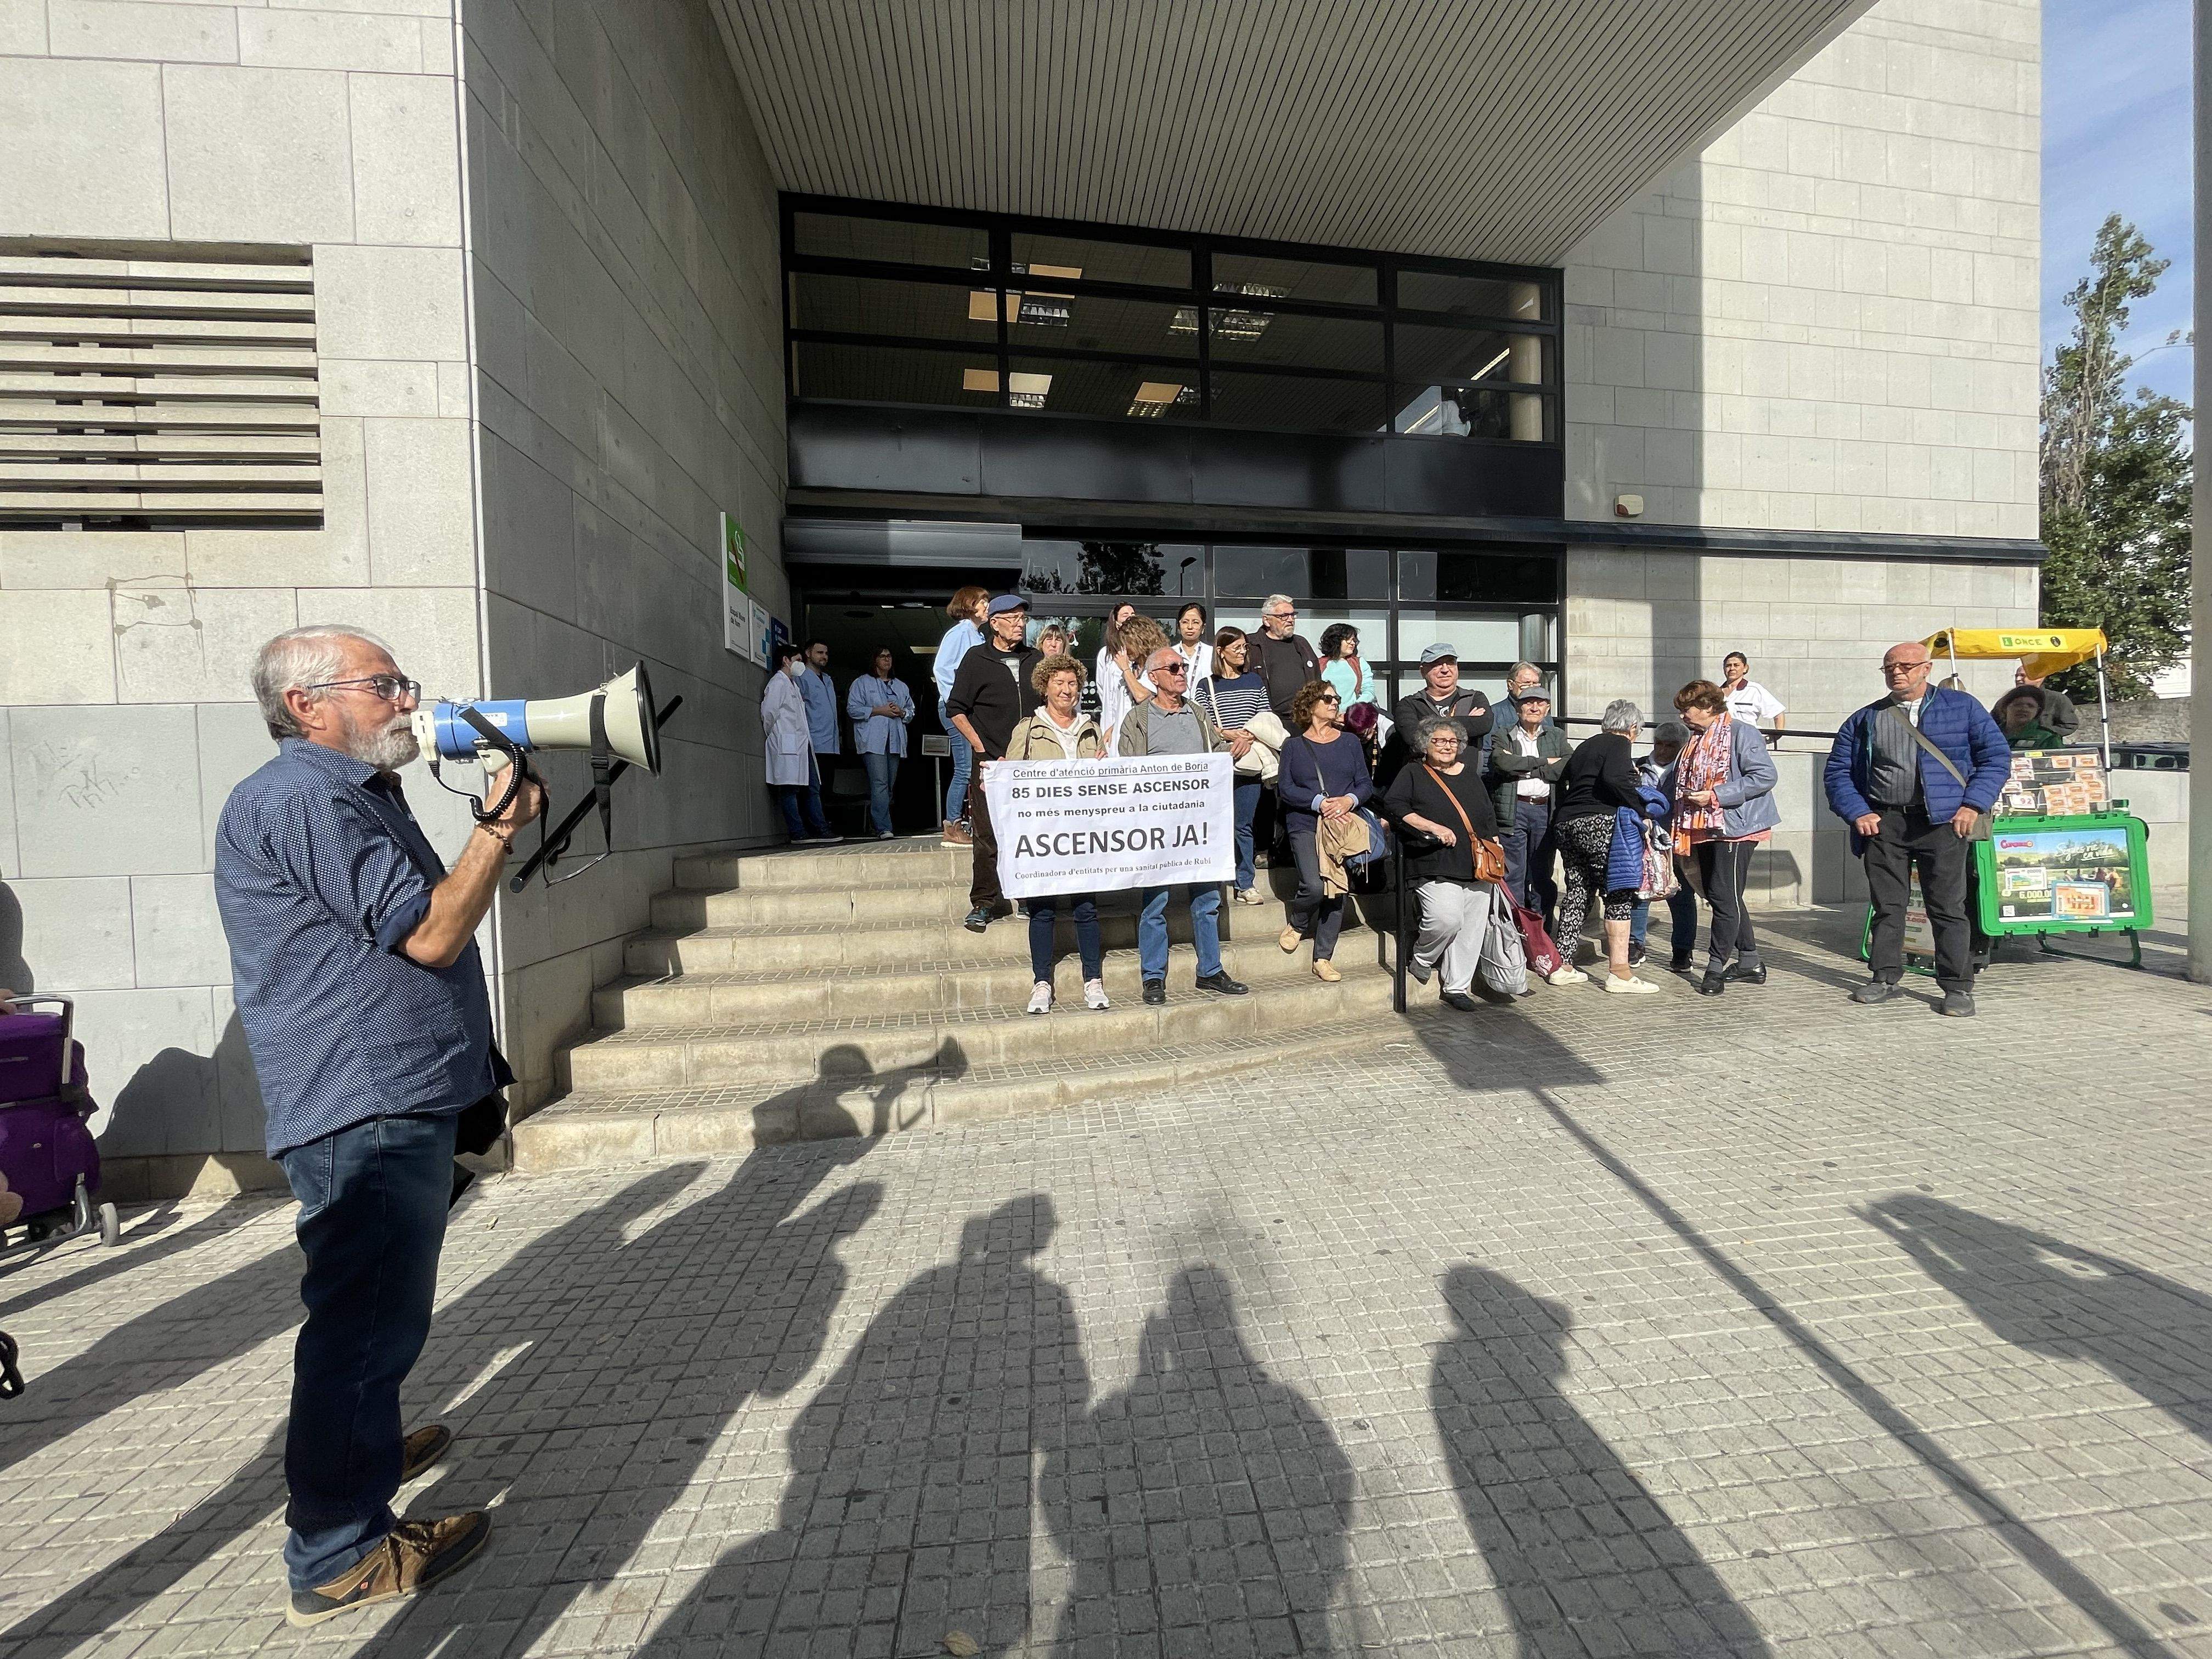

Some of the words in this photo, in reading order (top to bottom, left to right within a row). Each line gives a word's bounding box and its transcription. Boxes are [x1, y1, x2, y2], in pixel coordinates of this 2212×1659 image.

[1013, 770, 1047, 778] Centre
[1050, 766, 1095, 777] d'atenció
[1098, 765, 1138, 777] primària
[1141, 765, 1168, 773] Anton
[1171, 763, 1182, 771] de
[1185, 763, 1208, 771] Borja
[1012, 787, 1030, 798] 85
[1036, 786, 1073, 798] DIES
[1078, 783, 1127, 796] SENSE
[1133, 779, 1210, 793] ASCENSOR
[1036, 808, 1060, 817] més
[1064, 806, 1125, 817] menyspreu
[1152, 800, 1205, 811] ciutadania
[1015, 827, 1165, 858] ASCENSOR
[1172, 822, 1207, 848] JA!
[1015, 871, 1066, 879] Coordinadora
[1069, 867, 1103, 875] d'entitats
[1105, 866, 1118, 874] per
[1136, 862, 1158, 871] sanitat
[1159, 860, 1182, 870] pública
